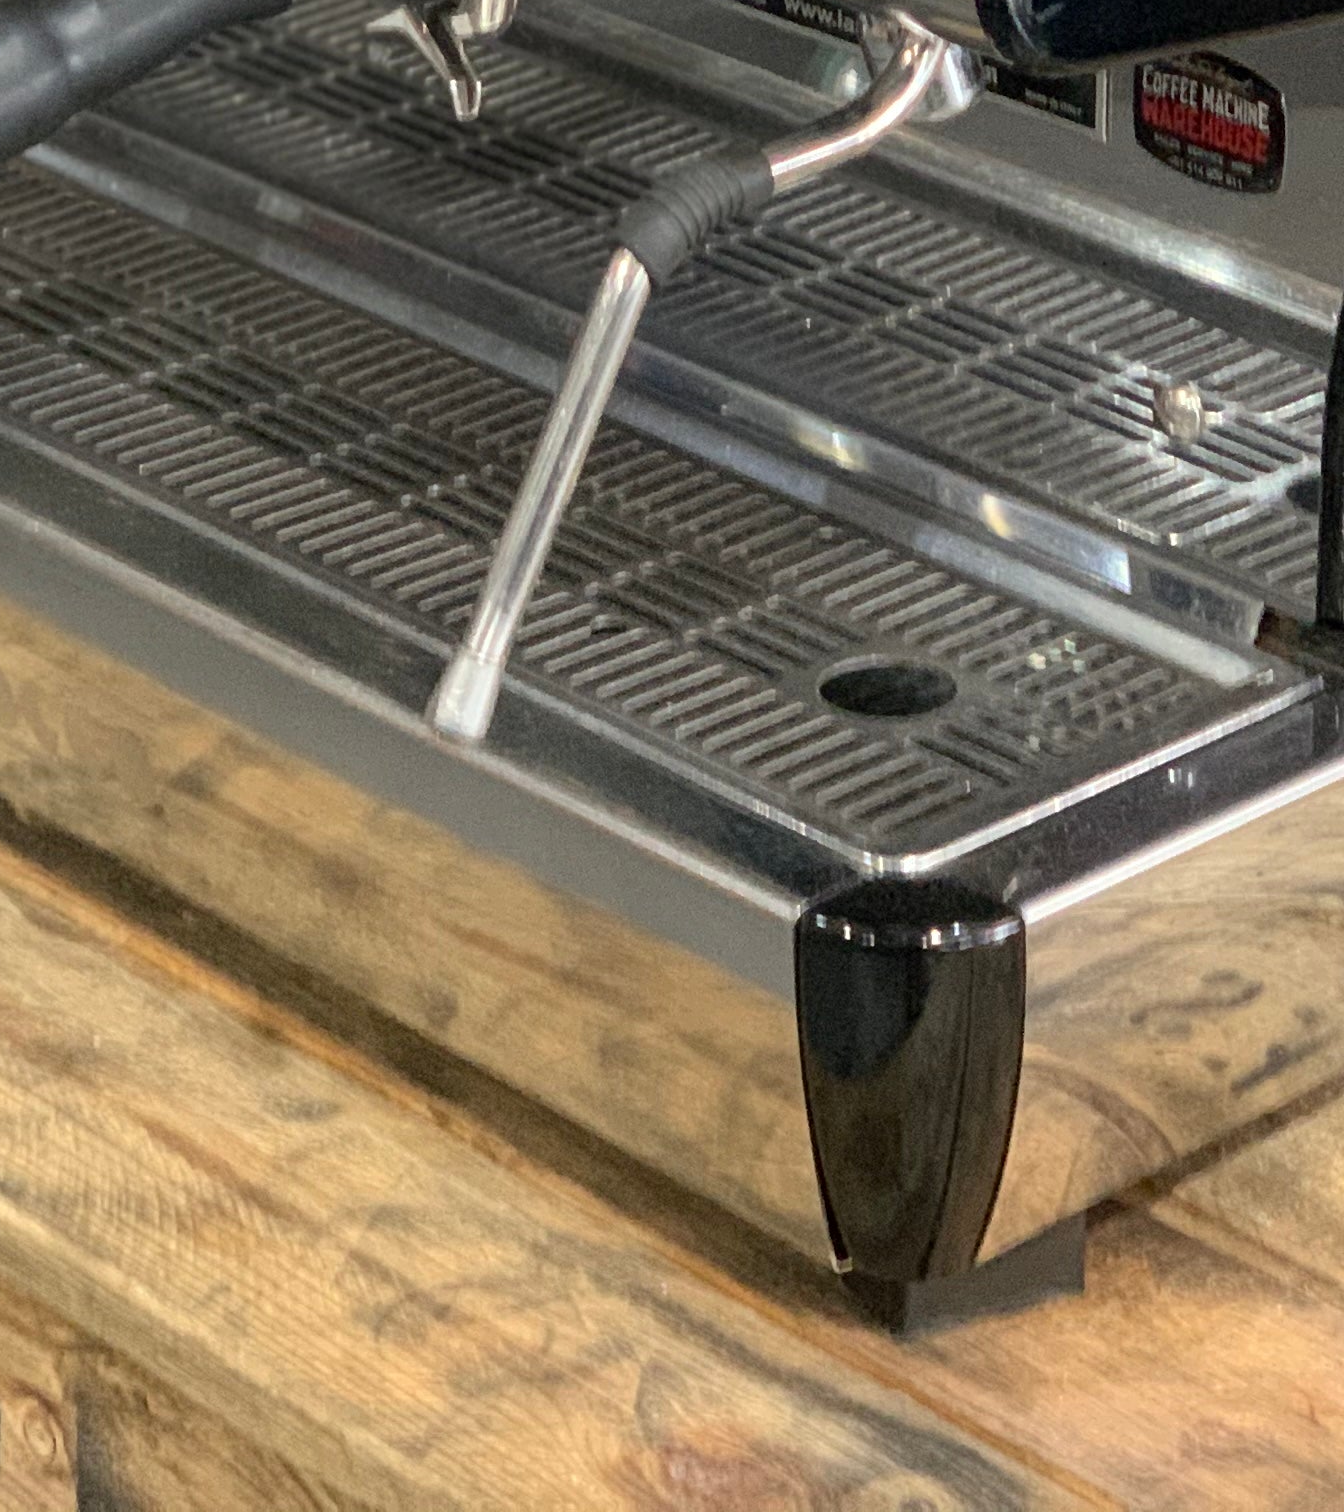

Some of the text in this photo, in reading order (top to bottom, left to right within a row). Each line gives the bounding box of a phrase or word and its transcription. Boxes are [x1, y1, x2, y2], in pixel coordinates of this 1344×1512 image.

[1142, 64, 1271, 134] COFFEE MACHINE
[1142, 91, 1272, 165] WAREHOUSE
